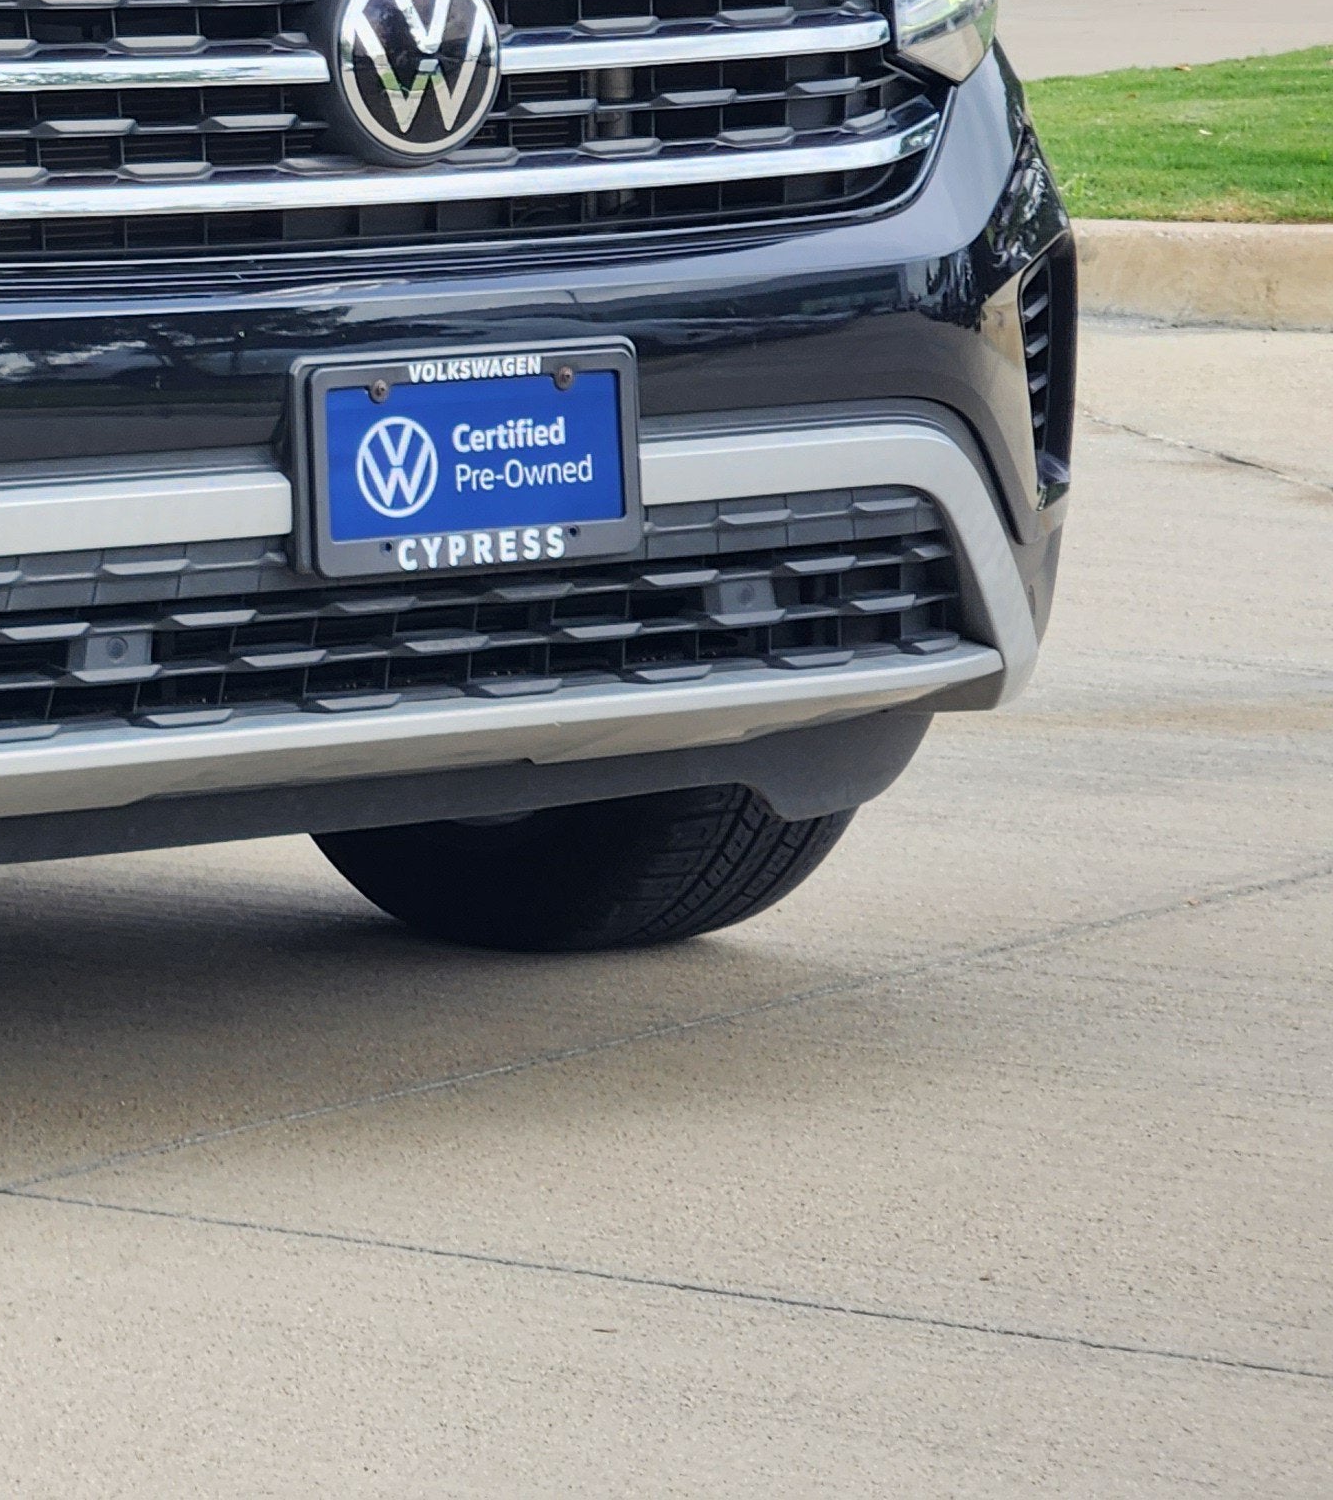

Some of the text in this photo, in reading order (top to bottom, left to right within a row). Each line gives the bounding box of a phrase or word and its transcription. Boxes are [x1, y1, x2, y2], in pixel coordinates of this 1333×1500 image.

[408, 355, 542, 383] VOLKSWAGEN
[452, 416, 566, 453] Certified
[356, 416, 439, 519] VW
[456, 454, 593, 492] Pre-Owned
[397, 525, 566, 572] CYPRESS
